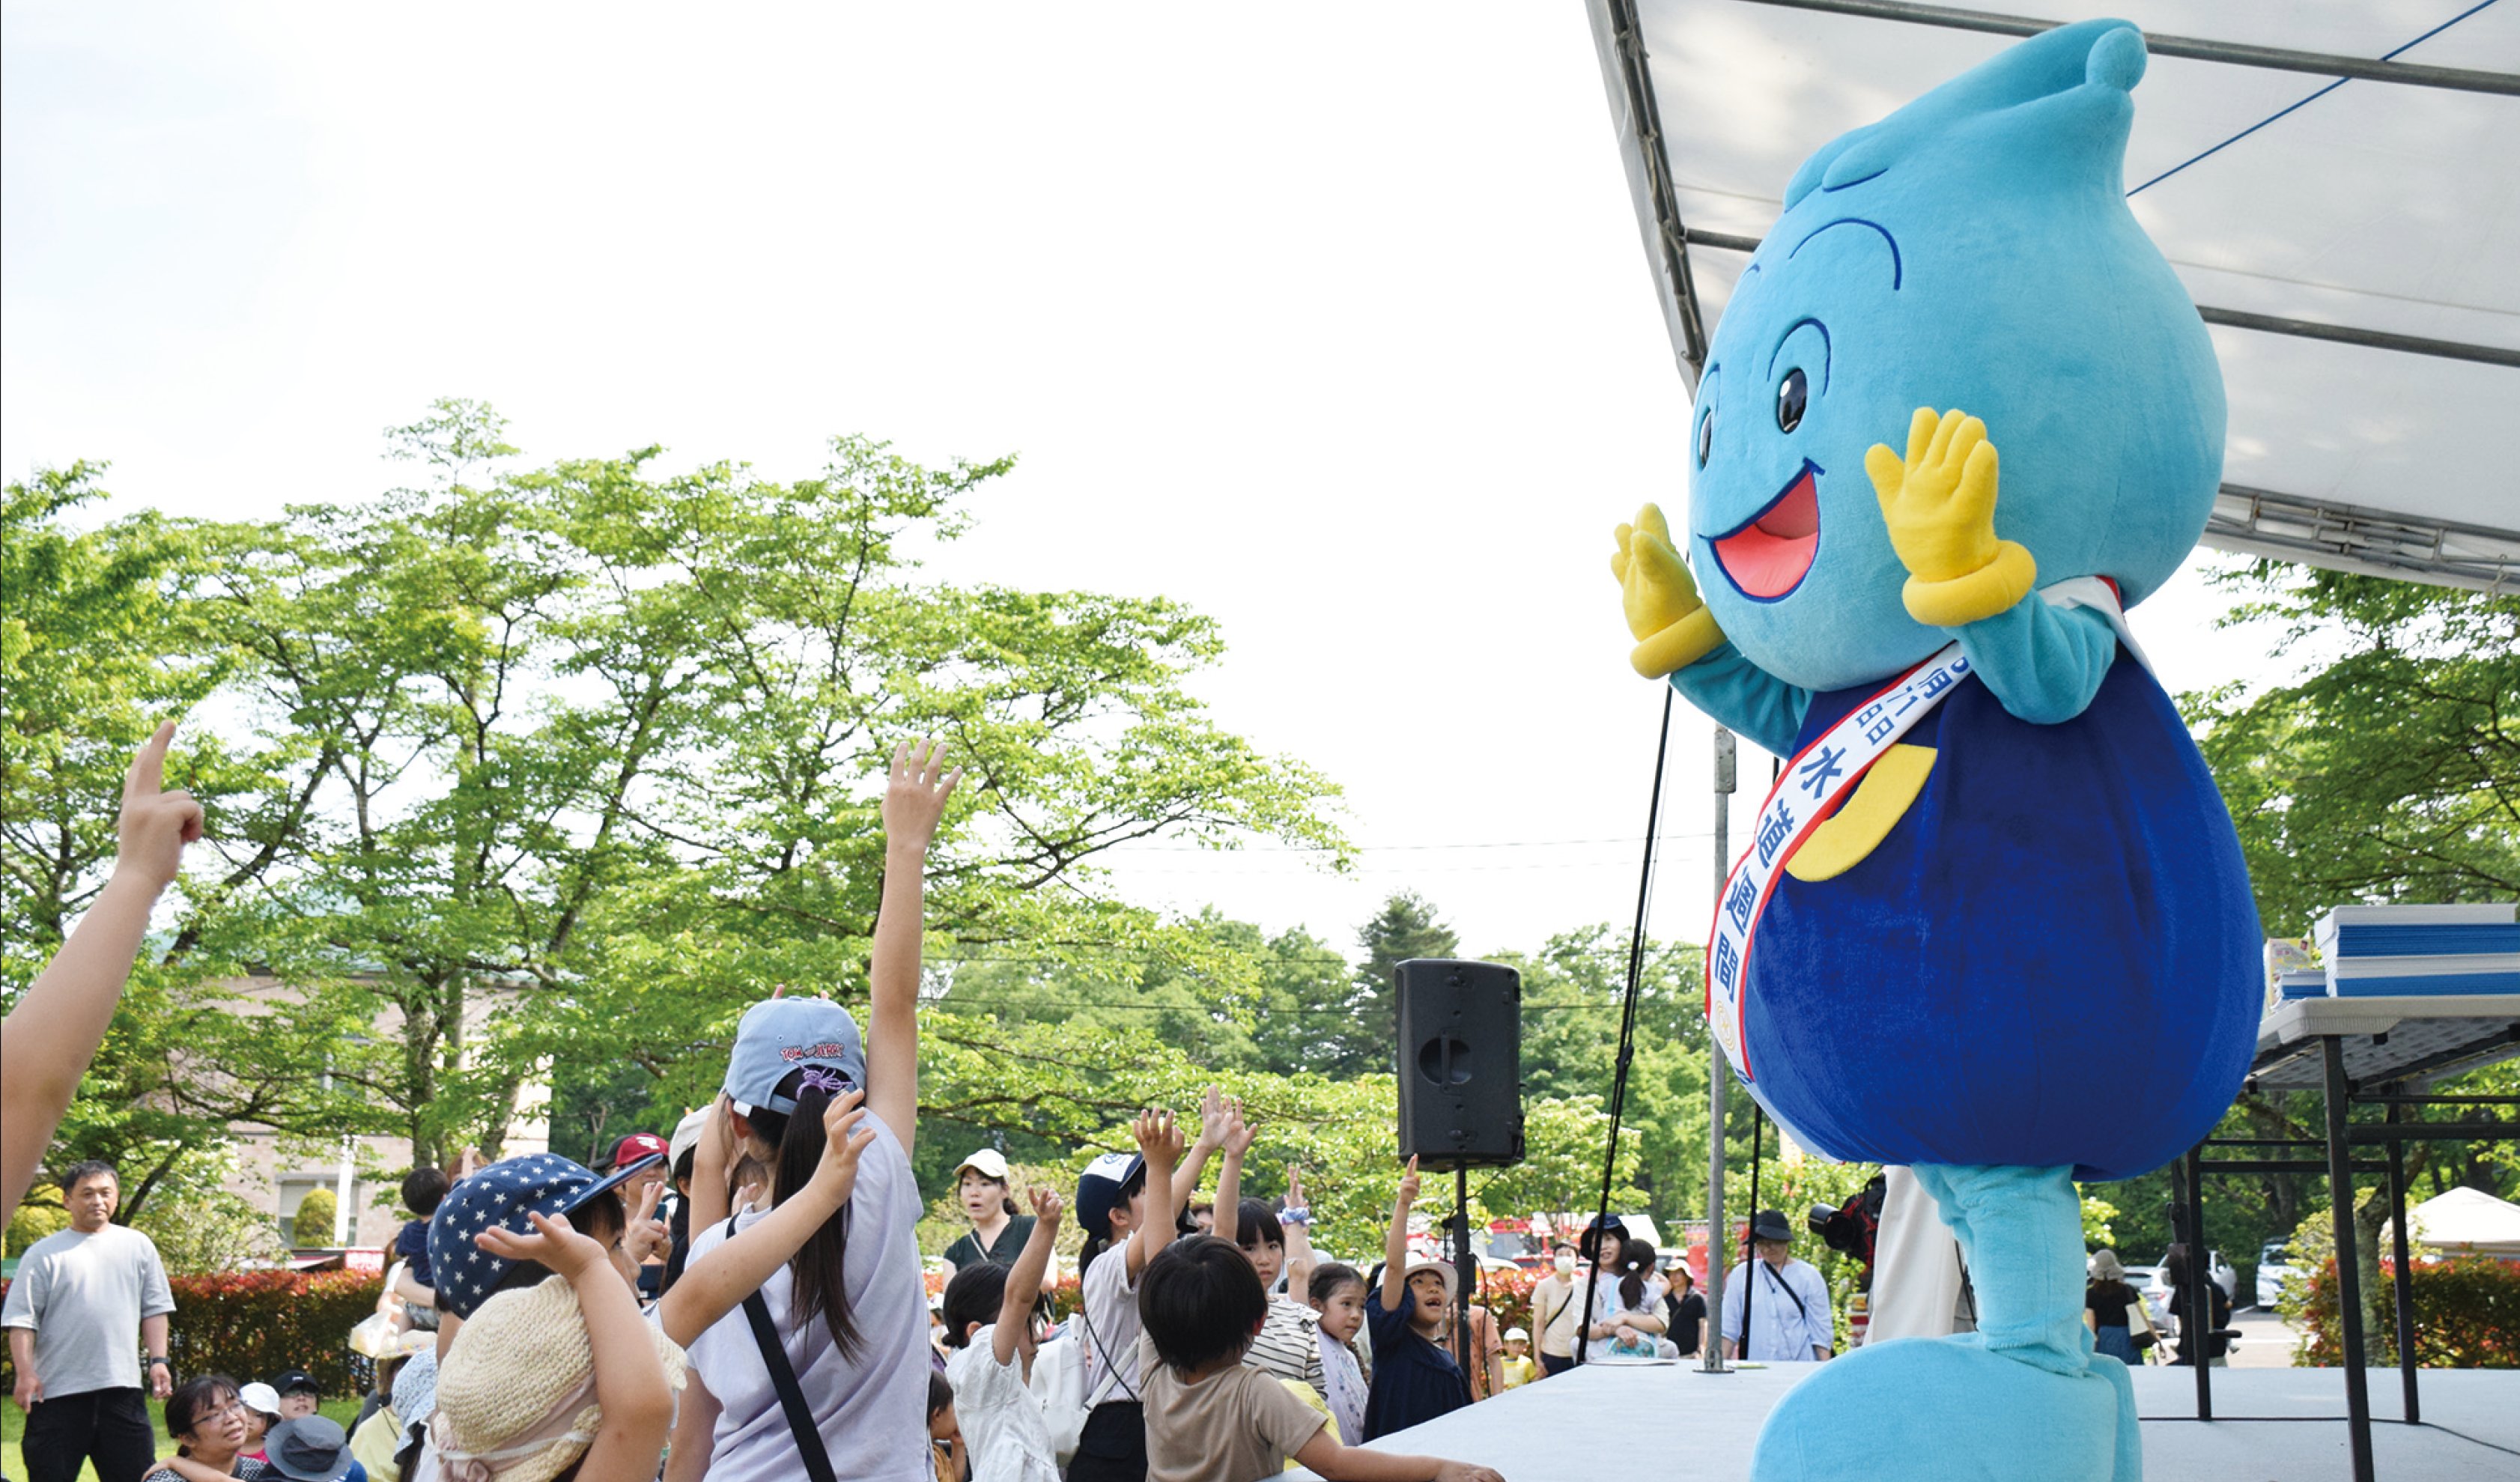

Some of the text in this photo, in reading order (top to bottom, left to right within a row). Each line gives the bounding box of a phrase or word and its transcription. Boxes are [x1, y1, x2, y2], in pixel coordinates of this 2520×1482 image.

[1714, 746, 1846, 1003] 水道週間
[780, 1045, 804, 1062] TOM
